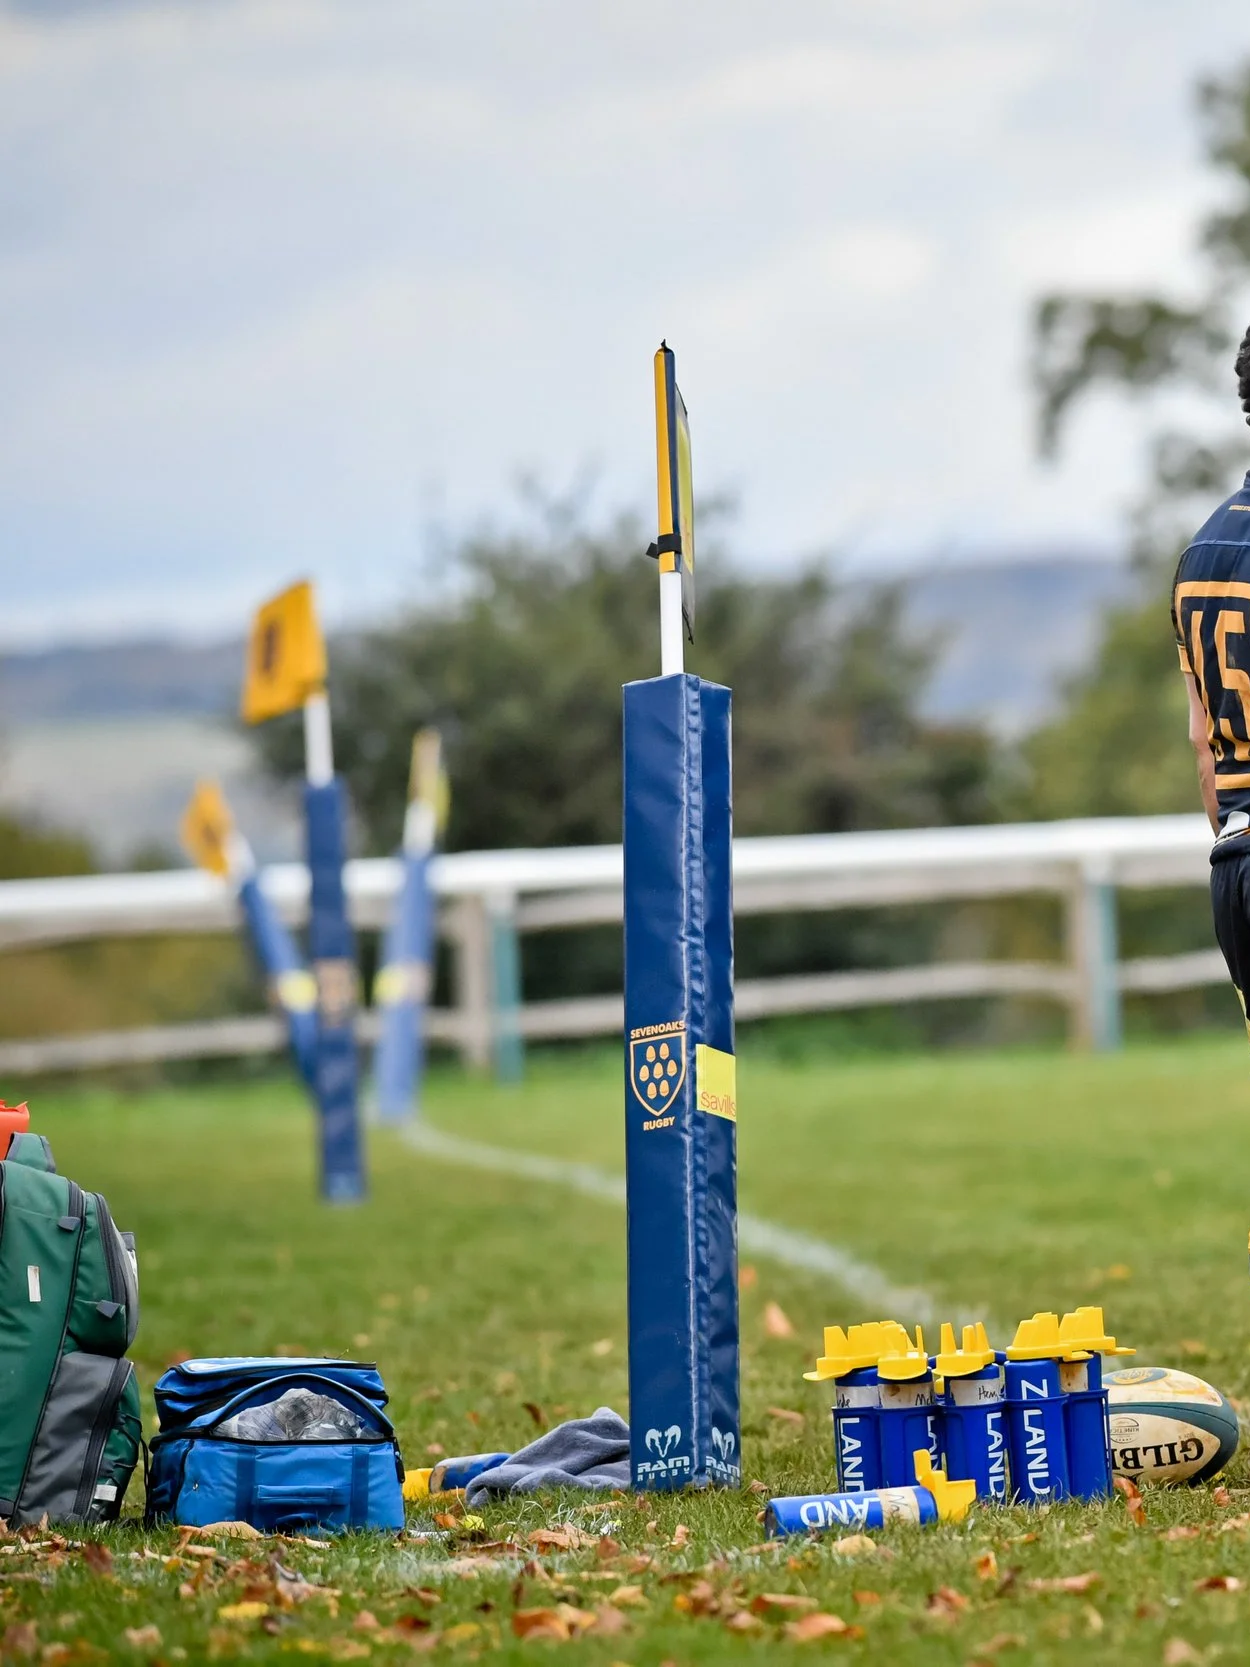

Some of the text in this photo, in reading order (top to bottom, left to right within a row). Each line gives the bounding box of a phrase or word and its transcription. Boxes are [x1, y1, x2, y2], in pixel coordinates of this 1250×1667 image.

[630, 1020, 686, 1039] SEVENOAKS
[643, 1116, 675, 1131] RUGBY
[637, 1455, 690, 1474] RAM
[986, 1411, 1006, 1499] LAND
[637, 1466, 690, 1482] RUGBY
[705, 1455, 740, 1478] RAM
[800, 1497, 881, 1532] LAND
